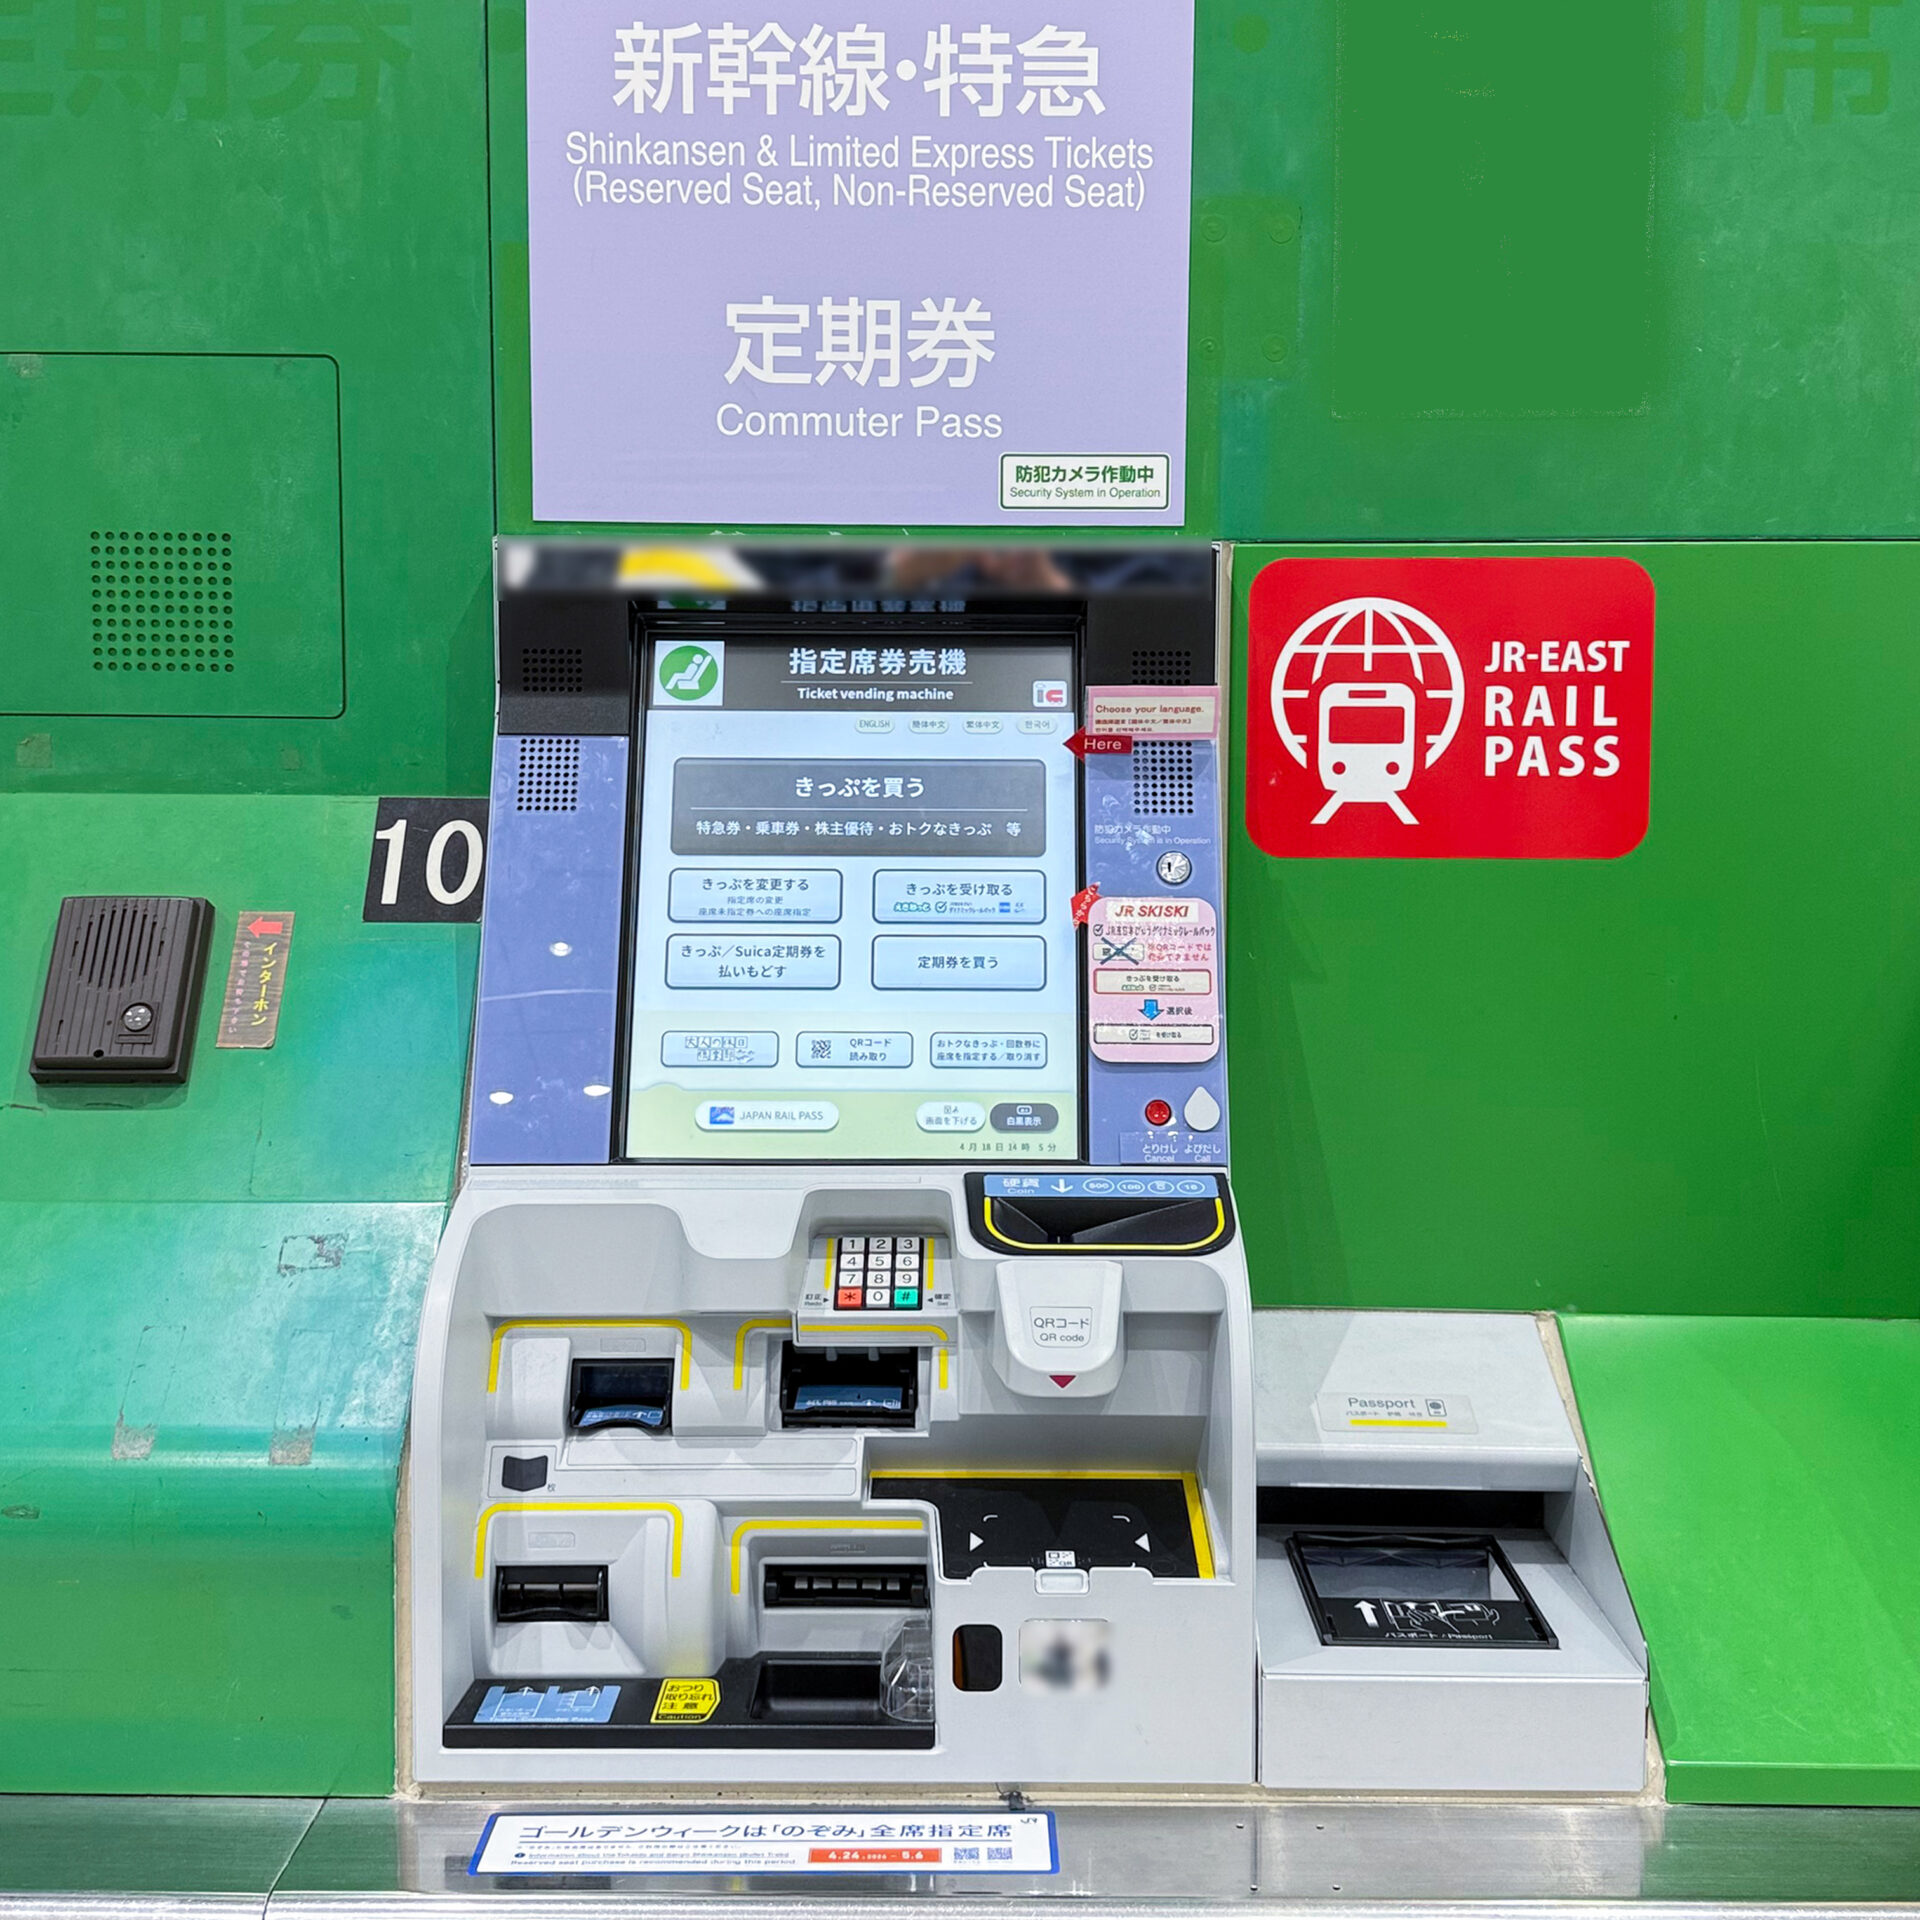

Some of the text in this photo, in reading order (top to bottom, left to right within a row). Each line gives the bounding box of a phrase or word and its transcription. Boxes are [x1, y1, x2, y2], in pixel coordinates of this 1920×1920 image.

[612, 21, 1106, 118] 新幹線・特急
[566, 132, 1154, 177] Shinkansen & Limited Express Tickets
[574, 170, 1146, 212] (Reserved Seat, Non-Reserved Seat)
[724, 295, 996, 389] 定期券
[716, 403, 1003, 438] Commuter Pass
[1015, 465, 1154, 484] 防犯カメラ作動中
[1010, 487, 1161, 500] Security System in Operation
[788, 647, 967, 676] 指定席券売機
[1484, 640, 1631, 673] JR-EAST
[797, 688, 954, 703] Ticket vending machine
[1095, 704, 1205, 715] Choose your language.
[1484, 685, 1619, 728] RAIL
[858, 720, 891, 729] ENGLISH
[1024, 720, 1051, 729] 한국어
[1084, 738, 1122, 751] Here
[1484, 735, 1621, 778] PASS
[795, 776, 926, 799] きっぷを買う
[695, 819, 1022, 837] 特急券・乗車券・株主優待・おトクなきっぷ 等
[1173, 836, 1212, 846] Operation
[375, 818, 484, 906] 10
[702, 877, 810, 892] きっぷを変更する
[906, 883, 1013, 897] きっぷを受け取る
[727, 895, 784, 905] 指定席の変更
[1115, 905, 1135, 918] JR
[917, 955, 999, 970] 定期券を買う
[718, 964, 788, 979] 払いもどす
[250, 942, 278, 1026] インターホン
[1166, 1006, 1194, 1016] 選択後
[849, 1038, 893, 1049] QRコード
[849, 1051, 887, 1062] 読み取り
[740, 1110, 824, 1121] JAPAN RAIL PASS
[925, 1116, 978, 1126] 画面を下げる
[1006, 1116, 1042, 1127] 白黒表示
[1142, 1143, 1221, 1154] とりけし よびだし
[1144, 1154, 1212, 1162] Cancel Call
[1121, 1183, 1141, 1191] 100
[849, 1239, 913, 1249] 1 2 3
[847, 1256, 912, 1266] 4 5 6
[846, 1273, 912, 1284] 7 8 9
[873, 1291, 883, 1302] 0
[1033, 1316, 1089, 1330] QRコード
[1040, 1332, 1085, 1342] QR code
[1348, 1396, 1416, 1410] Passport
[667, 1684, 705, 1692] おつり
[665, 1693, 714, 1701] 取り忘れ
[519, 1823, 1013, 1840] ゴールデンウィークは「のぞみ」全席指定席
